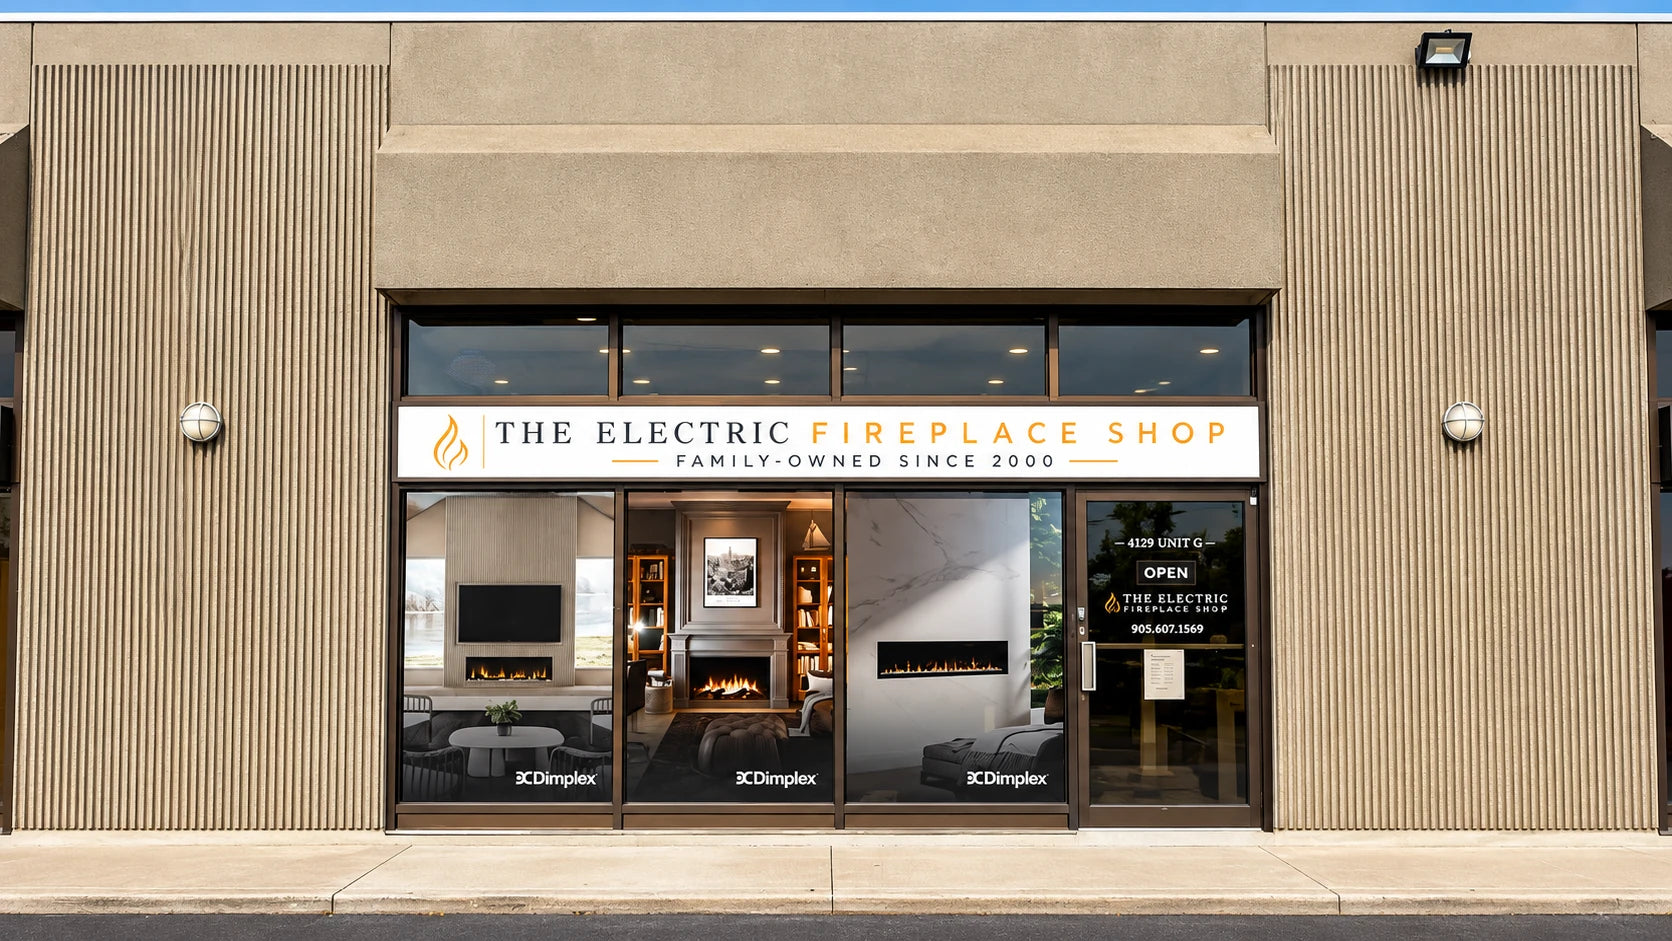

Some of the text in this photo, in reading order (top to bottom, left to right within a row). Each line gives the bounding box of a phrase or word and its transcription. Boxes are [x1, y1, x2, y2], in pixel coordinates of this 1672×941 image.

[495, 421, 1225, 445] THE ELECTRIC FIREPLACE SHOP
[676, 454, 1053, 468] FAMILY-OWNED SINCE 2000
[1127, 537, 1203, 548] 4129 UNIT G
[1144, 566, 1188, 579] OPEN
[1122, 593, 1228, 604] THE ELECTRIC
[1123, 605, 1228, 613] FIREPLACE SHOP
[1131, 624, 1204, 634] 905.607.1569
[533, 770, 597, 789] Dimplex
[753, 770, 817, 789] Dimplex
[984, 770, 1048, 789] Dimplex
